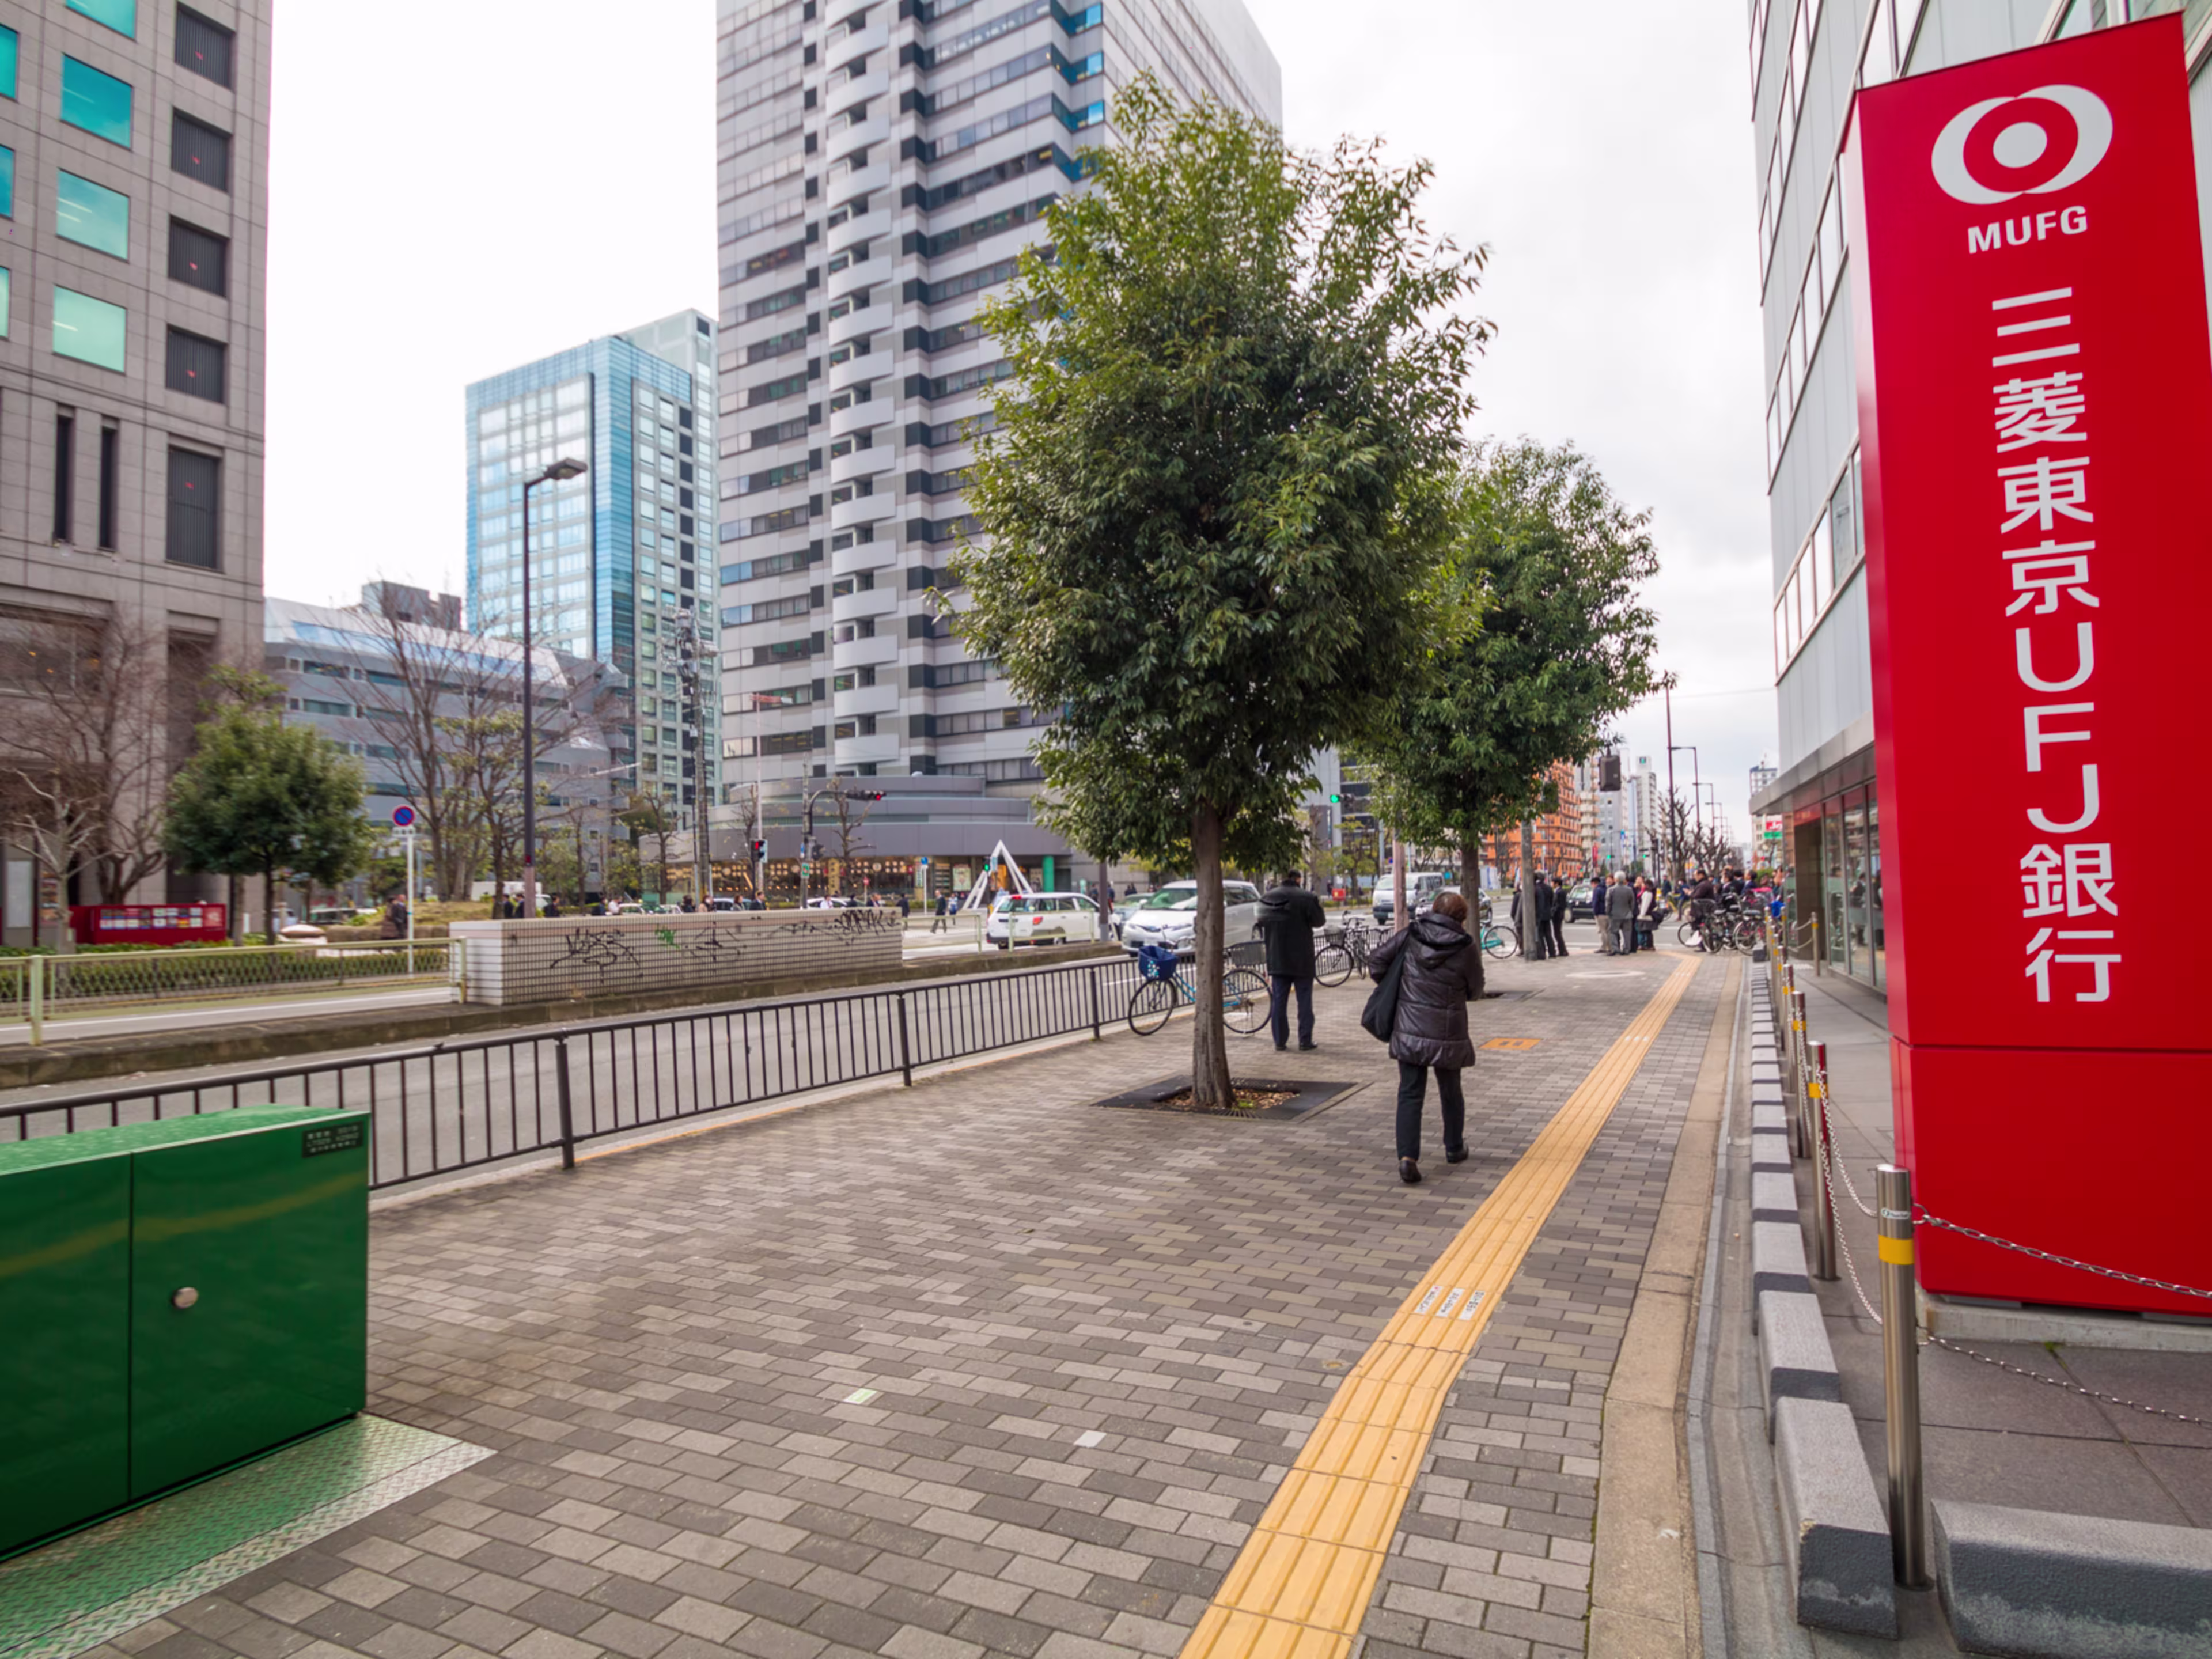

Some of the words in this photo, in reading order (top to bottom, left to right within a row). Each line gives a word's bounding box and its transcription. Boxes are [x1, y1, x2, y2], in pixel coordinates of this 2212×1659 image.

[1968, 205, 2088, 254] MUFG
[1992, 287, 2122, 1002] 三菱東京UFJ銀行
